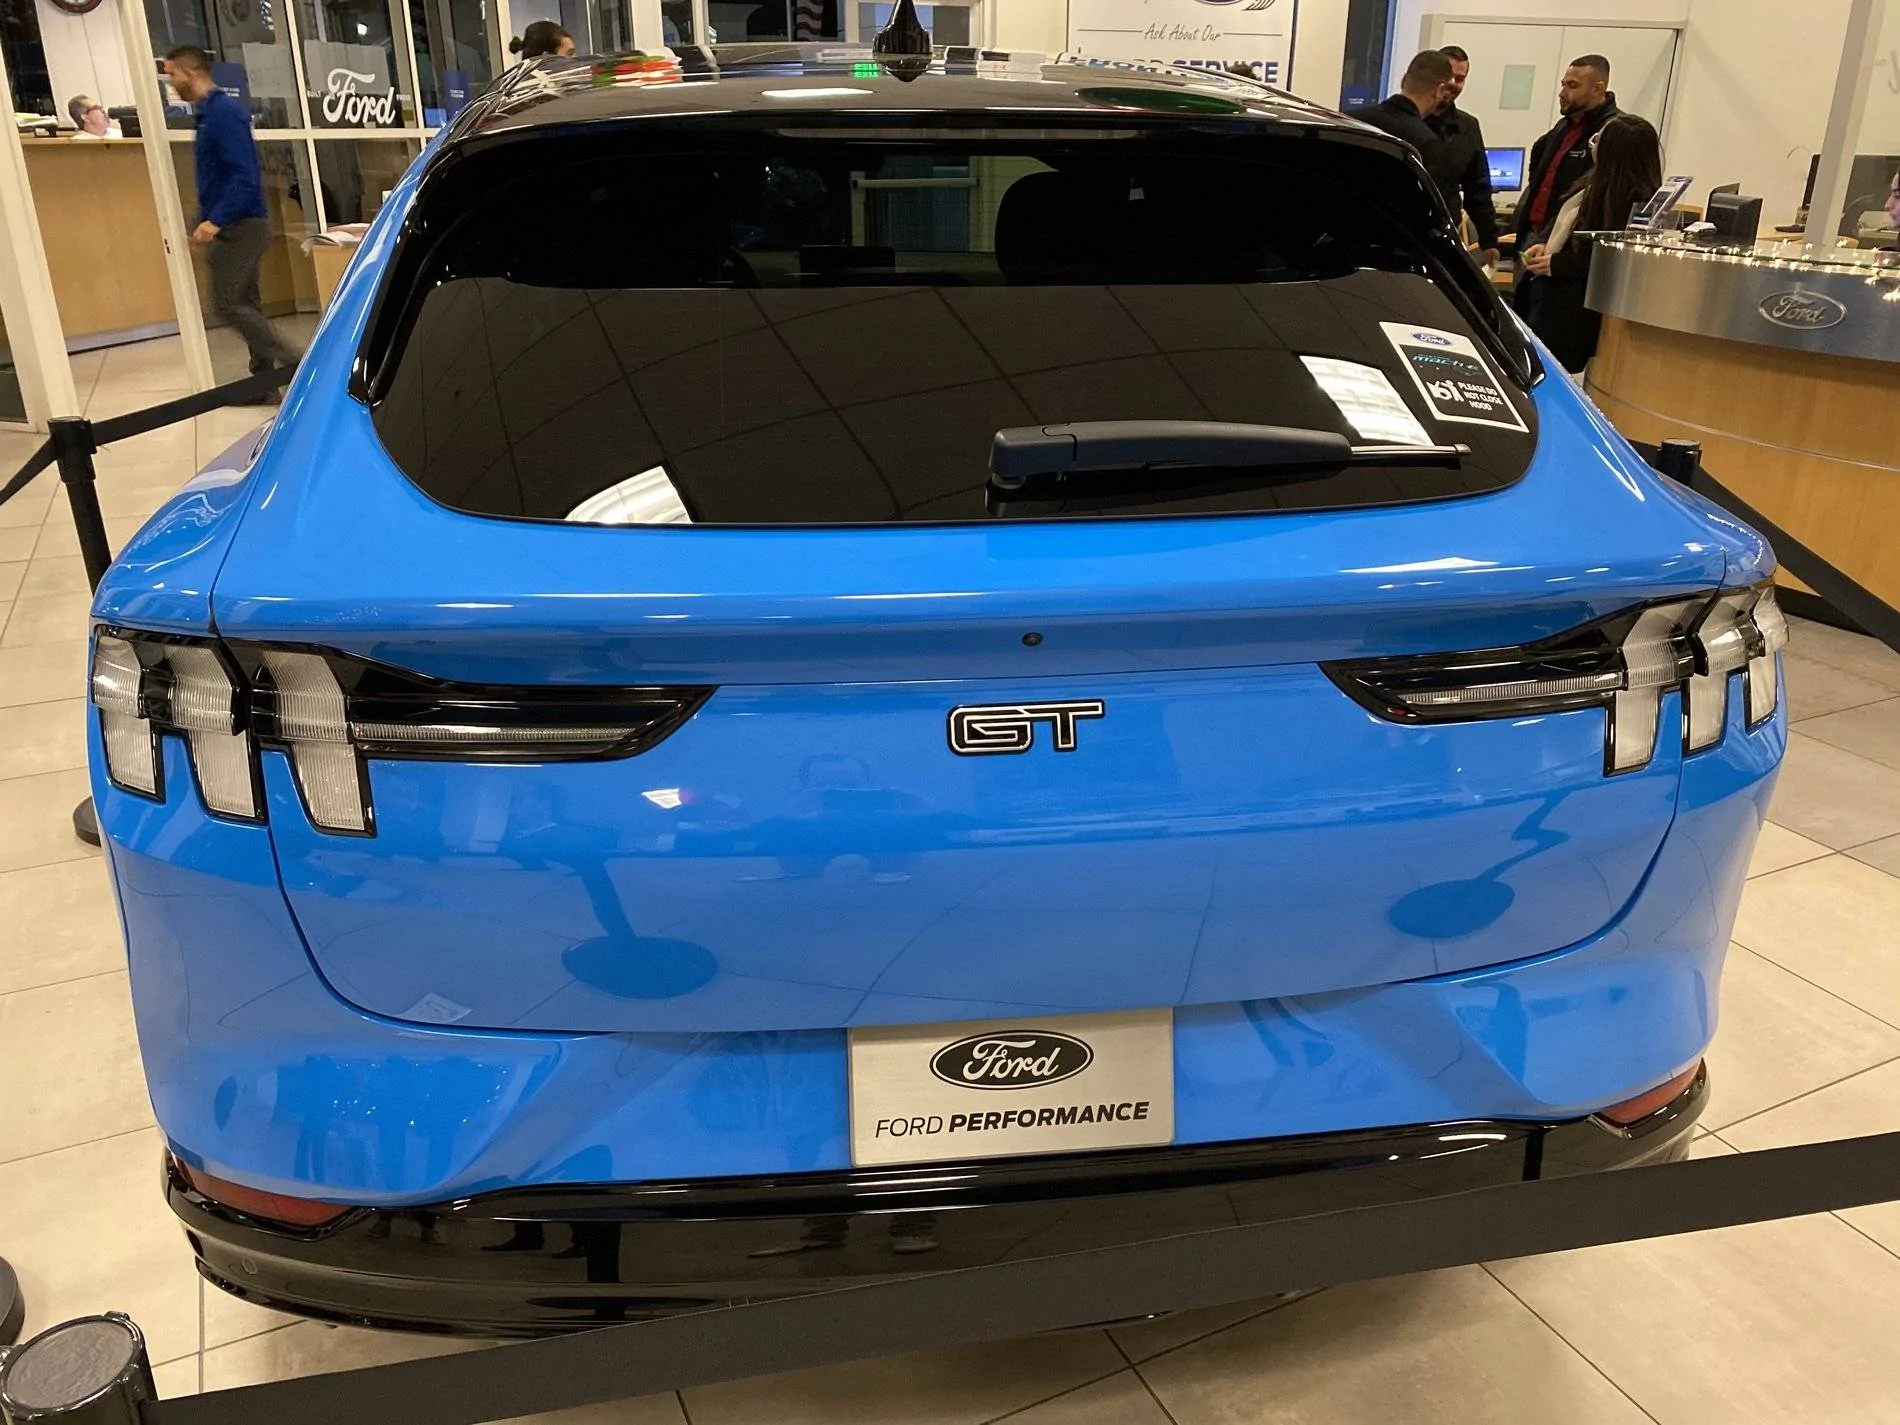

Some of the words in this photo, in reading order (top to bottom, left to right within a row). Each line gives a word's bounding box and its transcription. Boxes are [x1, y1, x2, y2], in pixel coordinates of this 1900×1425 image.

[1144, 22, 1167, 40] Ask
[1168, 23, 1199, 41] About
[1201, 24, 1222, 42] Our
[322, 67, 396, 125] Ford
[1772, 295, 1829, 323] Ford
[1457, 381, 1486, 393] PLEASE
[1485, 386, 1498, 396] DO
[1463, 391, 1480, 401] NOT
[1478, 393, 1504, 405] CLOSE
[1468, 400, 1493, 411] HOOD
[947, 699, 1104, 756] GT
[962, 1039, 1062, 1081] Ford
[875, 1115, 944, 1139] FORD
[948, 1100, 1151, 1133] PERFORMANCE
